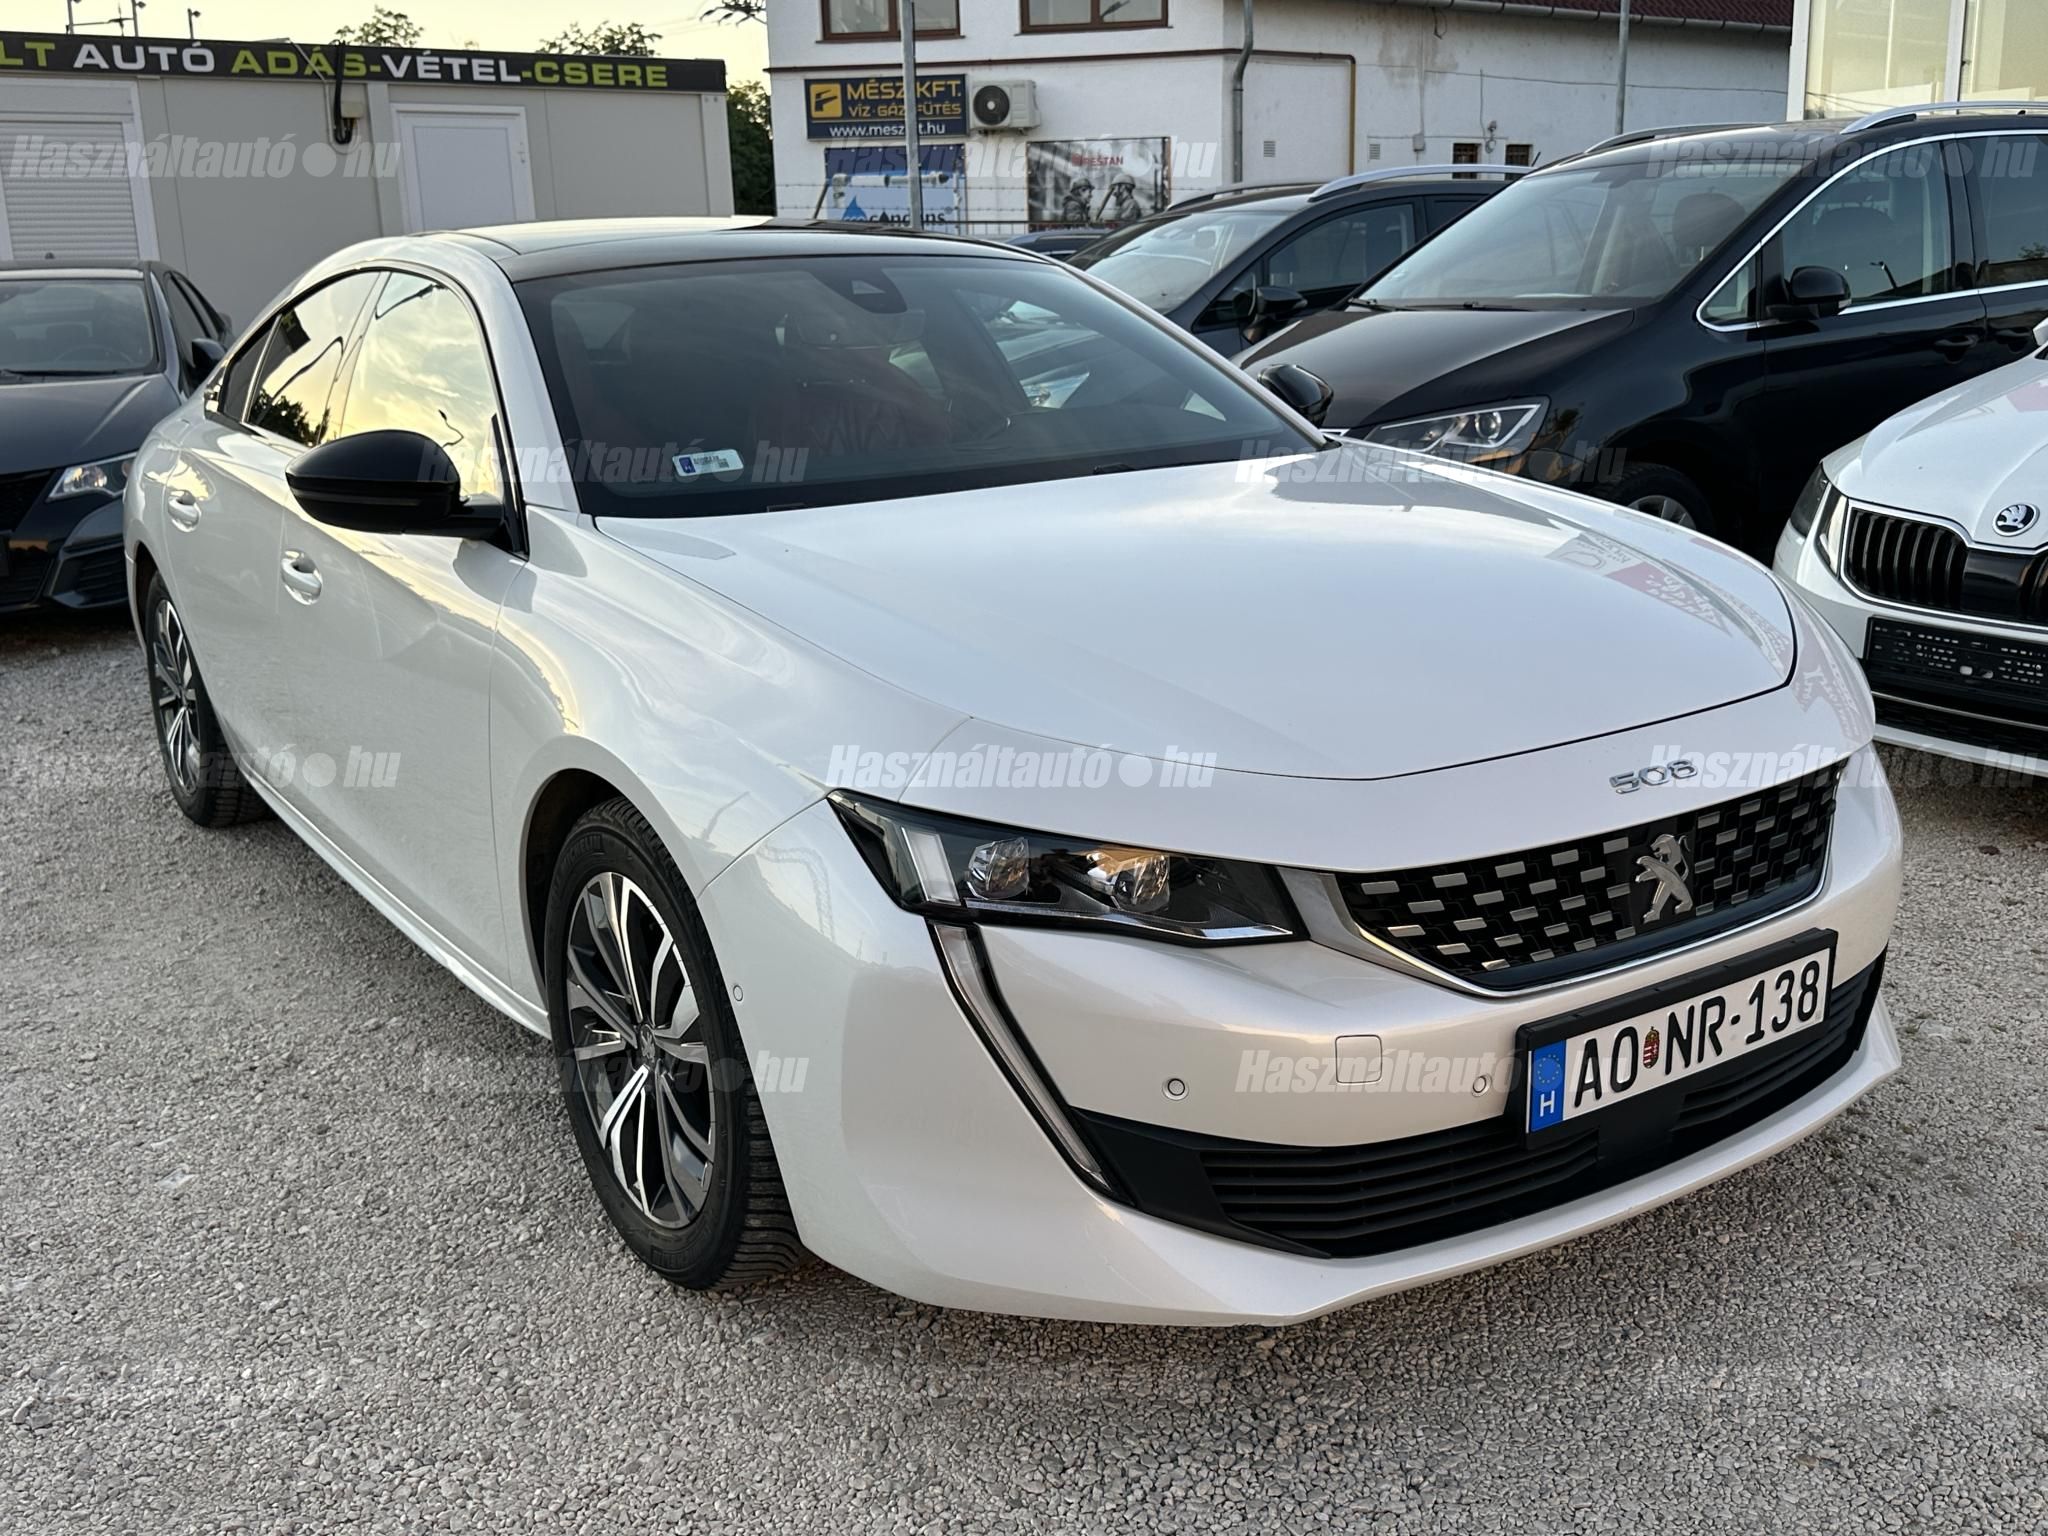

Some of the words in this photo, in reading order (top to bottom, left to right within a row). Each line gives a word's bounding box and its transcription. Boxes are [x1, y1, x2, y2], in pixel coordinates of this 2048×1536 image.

[73, 41, 215, 72] AUTÓ
[917, 80, 961, 98] KFT.
[1608, 760, 1699, 795] 508
[1573, 1026, 1638, 1108] AO
[1664, 960, 1821, 1076] NR-138
[1539, 1090, 1555, 1118] H
